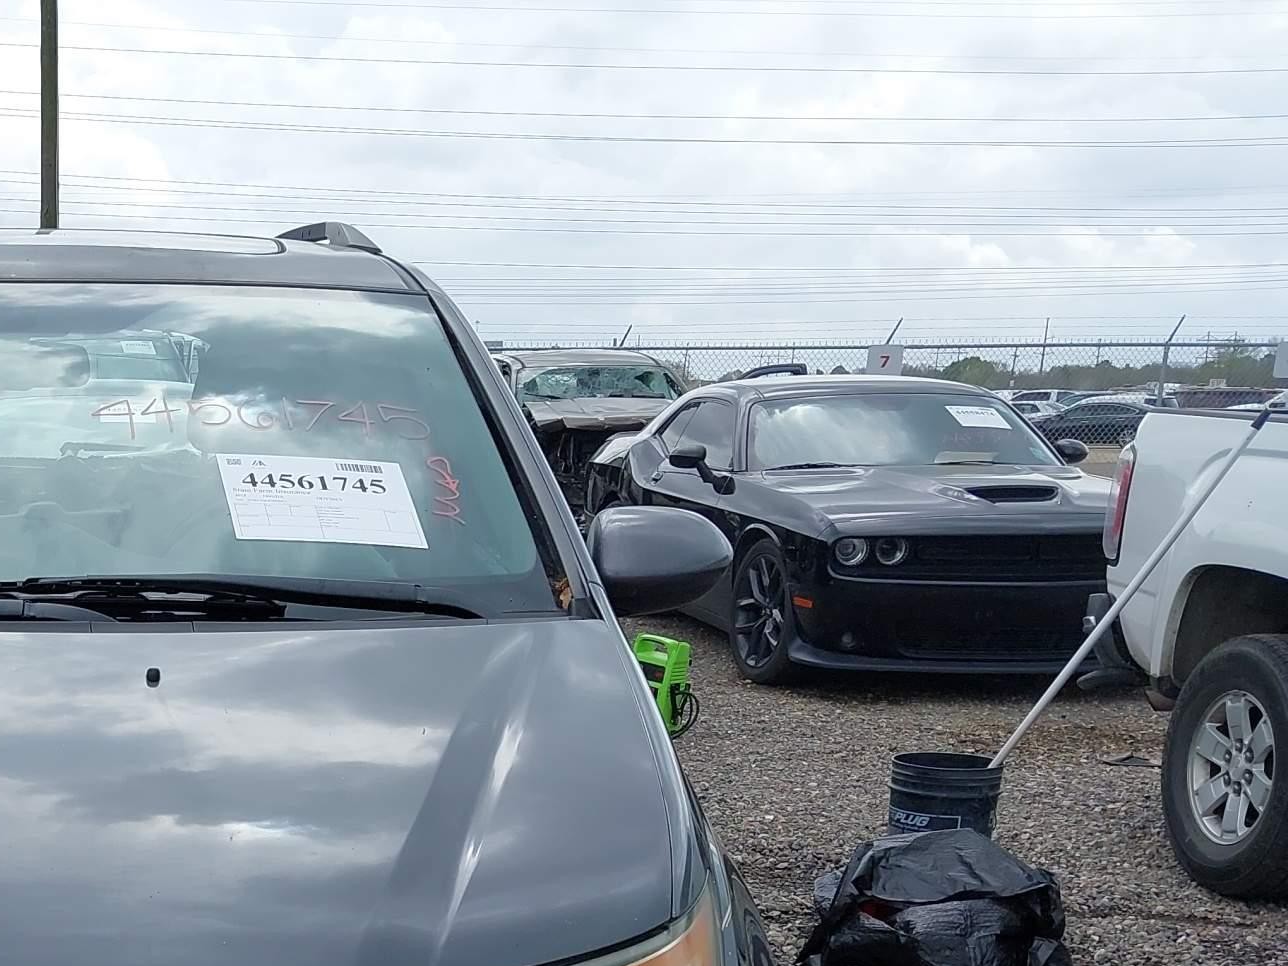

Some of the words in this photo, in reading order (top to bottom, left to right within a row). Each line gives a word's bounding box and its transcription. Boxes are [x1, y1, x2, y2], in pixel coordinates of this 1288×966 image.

[879, 355, 890, 369] 7
[91, 393, 431, 440] 44561745
[241, 472, 387, 495] 44561745
[894, 812, 930, 827] PLUG
